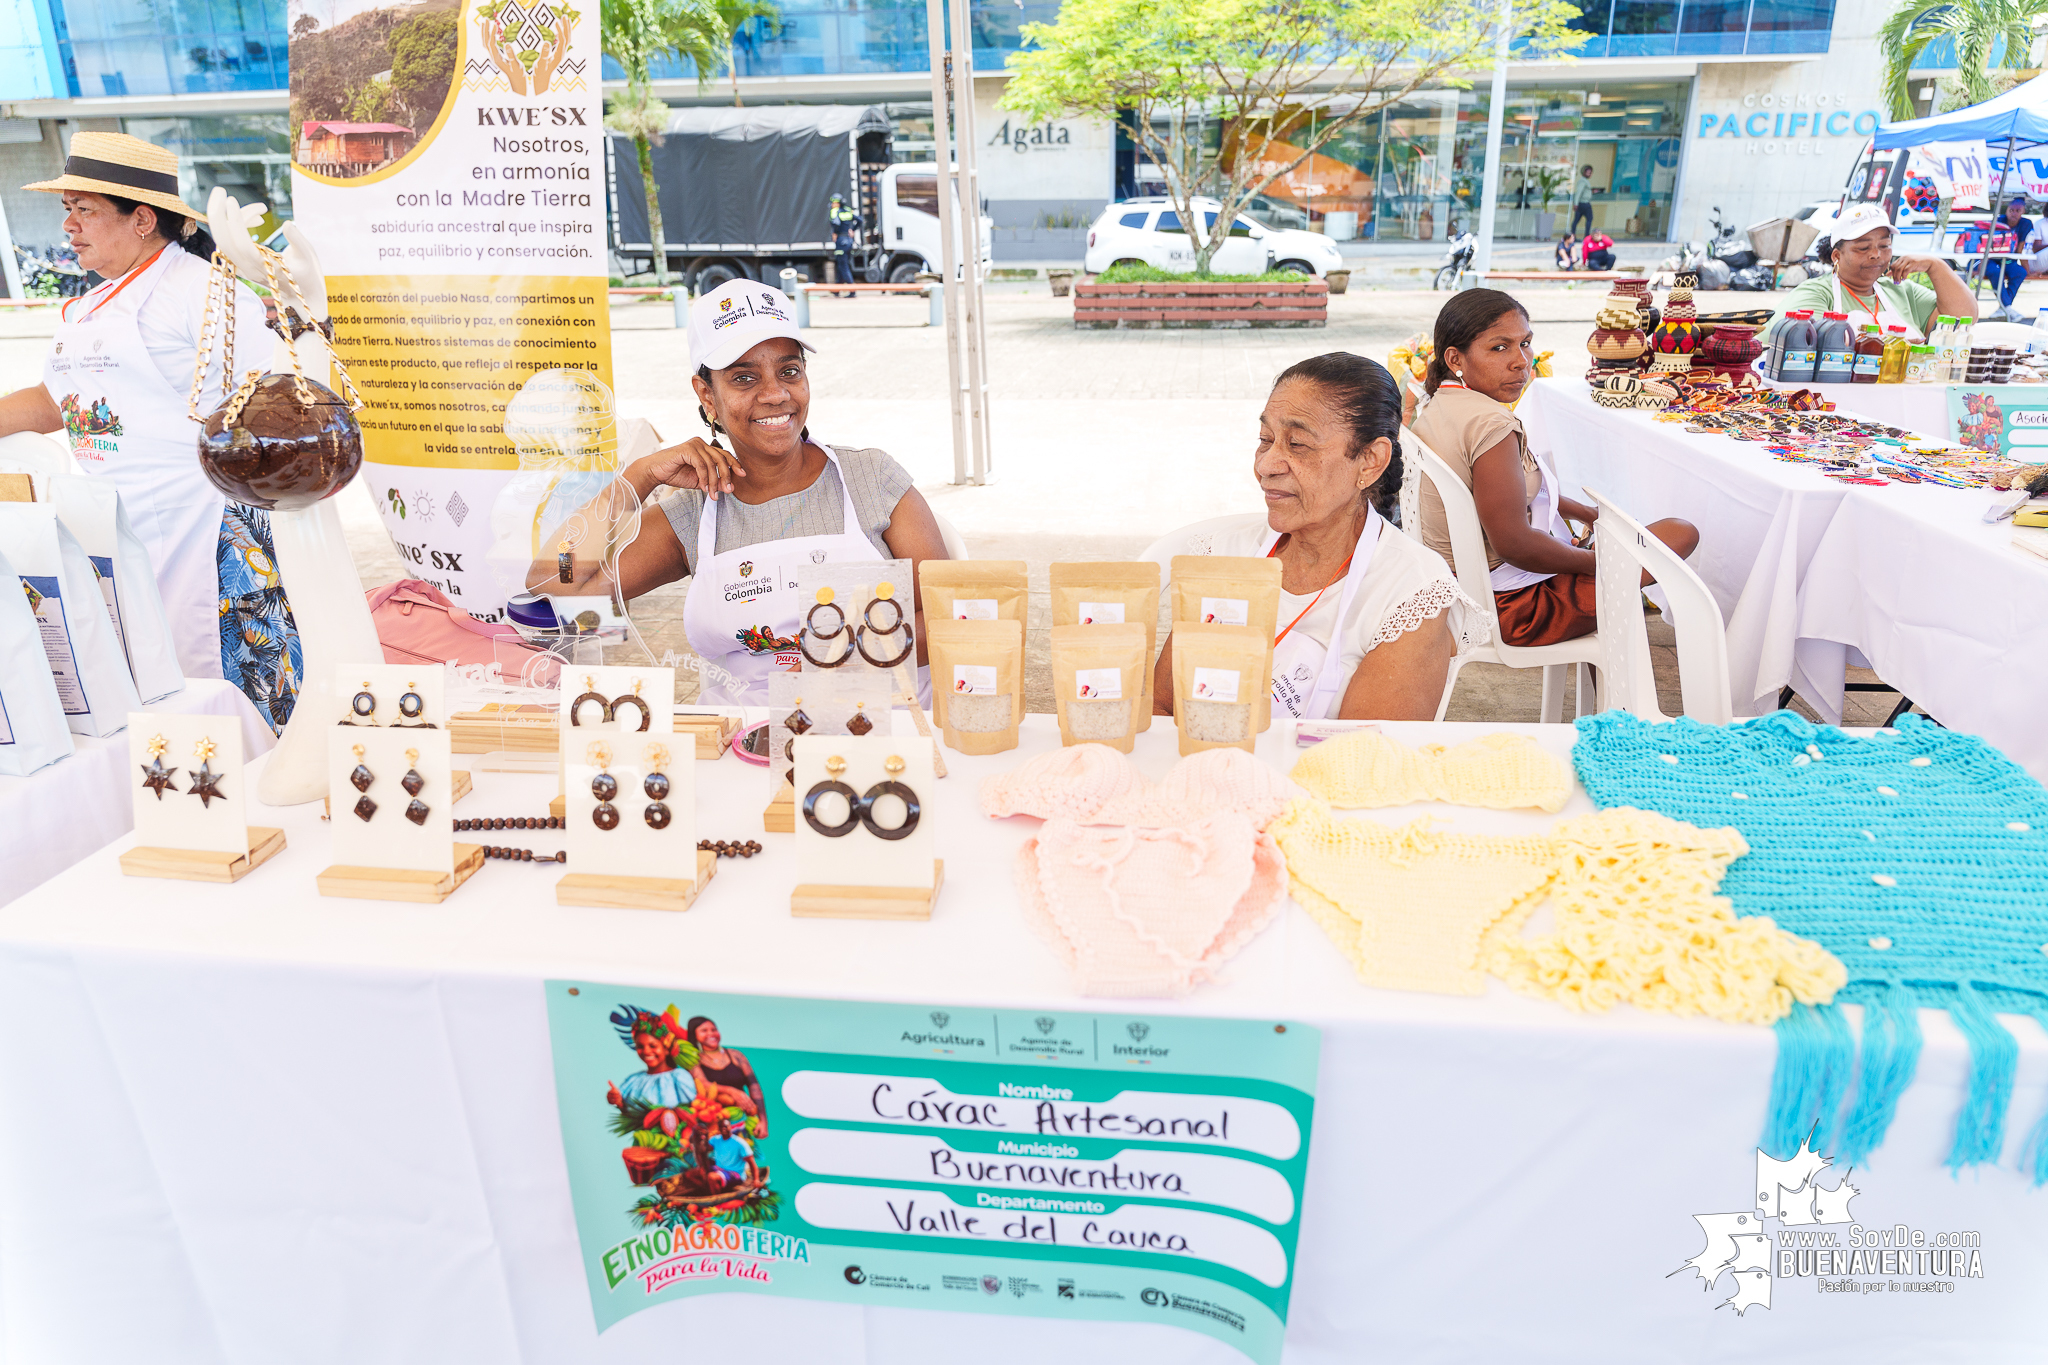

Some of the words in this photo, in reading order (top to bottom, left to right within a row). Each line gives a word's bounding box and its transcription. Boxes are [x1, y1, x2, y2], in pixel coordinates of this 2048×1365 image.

[1743, 92, 1847, 109] COSMOS
[1698, 110, 1882, 138] PACIFICO
[493, 136, 590, 156] Nosotros,
[1746, 141, 1825, 155] HOTEL
[472, 166, 496, 180] en
[502, 162, 590, 180] armonía
[396, 192, 430, 207] con
[436, 189, 452, 206] la
[463, 189, 525, 206] Madre
[531, 188, 591, 207] Tierra
[371, 219, 434, 234] sabiduría
[437, 220, 505, 234] ancestral
[508, 221, 536, 237] que
[540, 220, 592, 237] inspira
[379, 246, 405, 261] paz,
[408, 244, 473, 261] equilibrio
[476, 247, 484, 261] y
[488, 244, 592, 258] conservación.
[327, 293, 348, 303] esde
[350, 293, 358, 303] el
[360, 292, 399, 303] corazón
[402, 293, 418, 303] del
[420, 293, 458, 306] pueblo
[460, 293, 493, 304] Nasa,
[495, 293, 575, 306] compartimos
[578, 295, 594, 305] un
[332, 314, 348, 325] ado
[351, 314, 361, 325] de
[363, 313, 408, 326] armonía,
[411, 314, 462, 328] equilibrio
[464, 317, 471, 328] y
[473, 317, 496, 328] paz,
[499, 316, 513, 326] en
[516, 315, 571, 327] conexión
[573, 317, 596, 327] con
[334, 336, 361, 346] Madre
[363, 335, 393, 346] Tierra.
[395, 336, 441, 347] Nuestros
[444, 337, 495, 348] sistemas
[497, 337, 511, 348] de
[514, 337, 597, 349] conocimiento
[341, 356, 368, 369] spiran
[370, 359, 388, 368] este
[391, 359, 440, 370] producto,
[442, 360, 462, 371] que
[465, 359, 501, 371] refleja
[503, 360, 513, 369] el
[516, 361, 561, 373] respeto
[564, 361, 584, 373] por
[587, 361, 598, 371] la
[361, 379, 409, 389] naturaleza
[411, 380, 417, 392] y
[419, 379, 429, 389] la
[431, 380, 505, 391] conservación
[508, 381, 523, 391] de
[538, 382, 600, 393] ancestral.
[404, 402, 437, 411] somos
[439, 402, 490, 413] nosotros,
[563, 403, 600, 415] juntos
[378, 422, 389, 431] un
[390, 420, 418, 431] futuro
[420, 423, 431, 432] en
[434, 422, 443, 432] el
[445, 424, 465, 434] que
[467, 424, 477, 433] la
[480, 423, 536, 434] sabiduría
[595, 427, 602, 438] y
[424, 442, 434, 453] la
[436, 443, 458, 454] vida
[461, 445, 473, 454] se
[540, 448, 555, 456] en
[557, 446, 603, 456] unidad.
[447, 578, 462, 596] la
[724, 577, 759, 592] Gobierno
[761, 575, 772, 584] de
[725, 584, 773, 602] Colombia
[775, 654, 800, 665] para
[661, 648, 751, 699] Artesanal
[1280, 673, 1296, 694] encia
[1284, 697, 1302, 719] Rural
[901, 1030, 985, 1048] Agricultura
[1021, 1035, 1058, 1047] Agencia
[1061, 1038, 1073, 1047] de
[1113, 1043, 1170, 1058] Interior
[998, 1081, 1074, 1101] Nombre
[872, 1083, 1007, 1127] Cárac
[1035, 1101, 1229, 1140] Artesanal
[997, 1140, 1079, 1159] Municipio
[930, 1148, 1191, 1195] Buenaventura
[976, 1191, 1106, 1214] Departamento
[886, 1200, 987, 1236] Valle
[1003, 1215, 1057, 1245] del
[1082, 1221, 1195, 1254] Cauca
[601, 1224, 810, 1290] ETNOAGROFERIA
[646, 1261, 695, 1294] para
[699, 1256, 720, 1274] la
[721, 1258, 771, 1283] Vida
